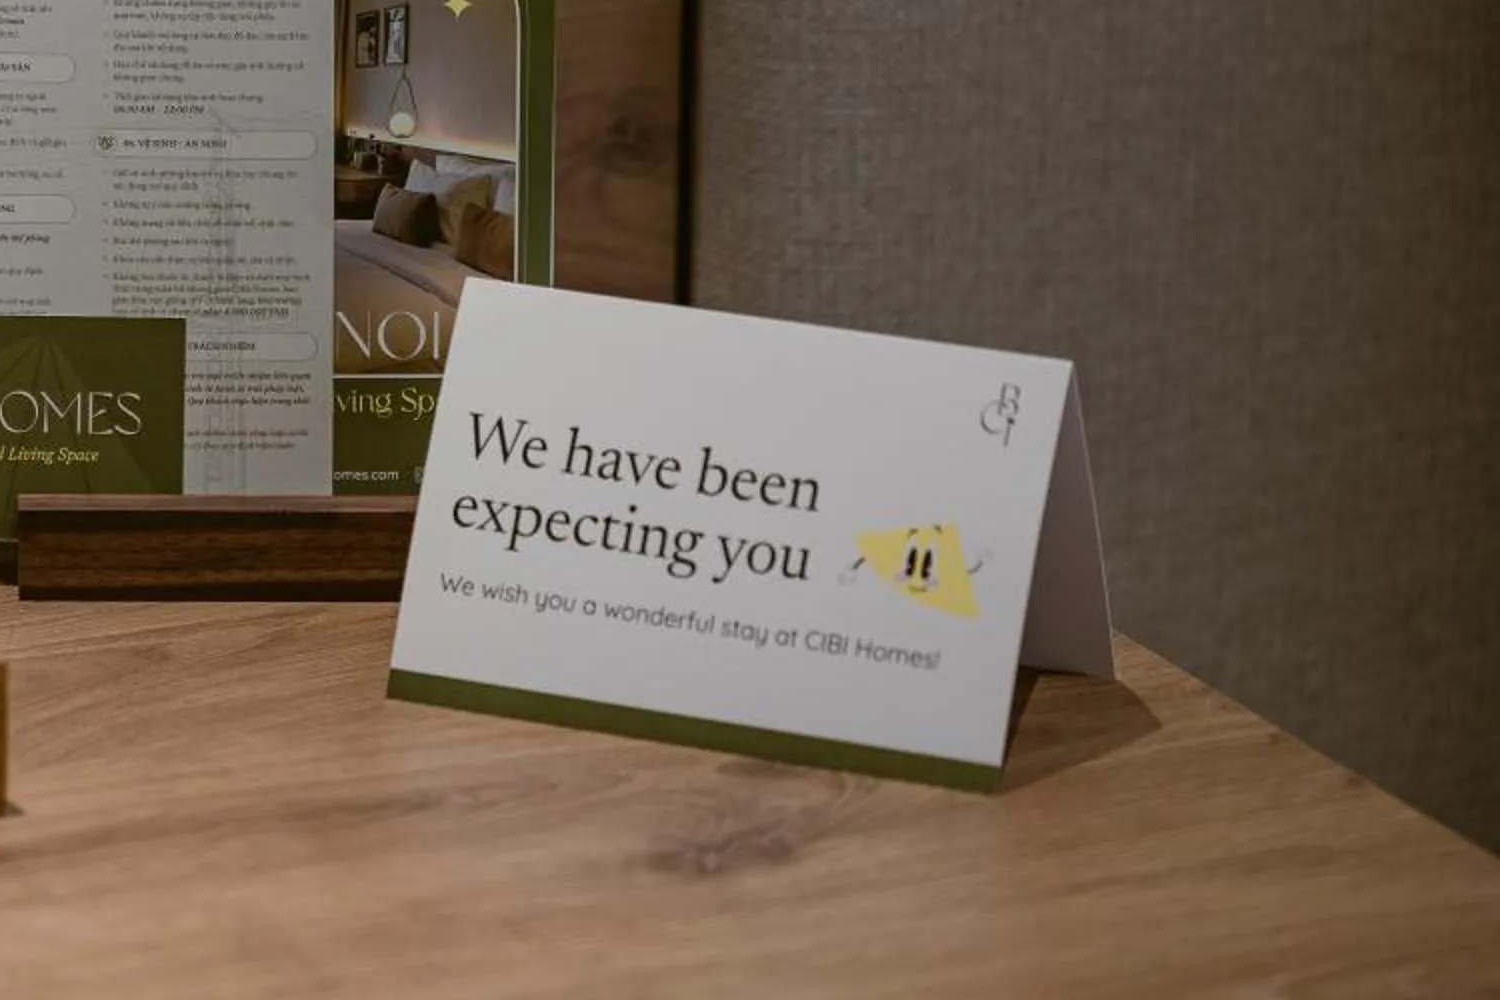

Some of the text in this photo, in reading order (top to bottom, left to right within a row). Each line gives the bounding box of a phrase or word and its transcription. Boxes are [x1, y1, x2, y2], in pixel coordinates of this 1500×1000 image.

[333, 385, 436, 422] ving Sp
[7, 445, 54, 466] Living
[57, 447, 100, 465] Space
[334, 468, 400, 482] omes.com
[467, 410, 822, 512] We have been
[449, 493, 813, 584] expecting you
[439, 571, 942, 672] We wish you a wonderful stay at CIBI Homes!
